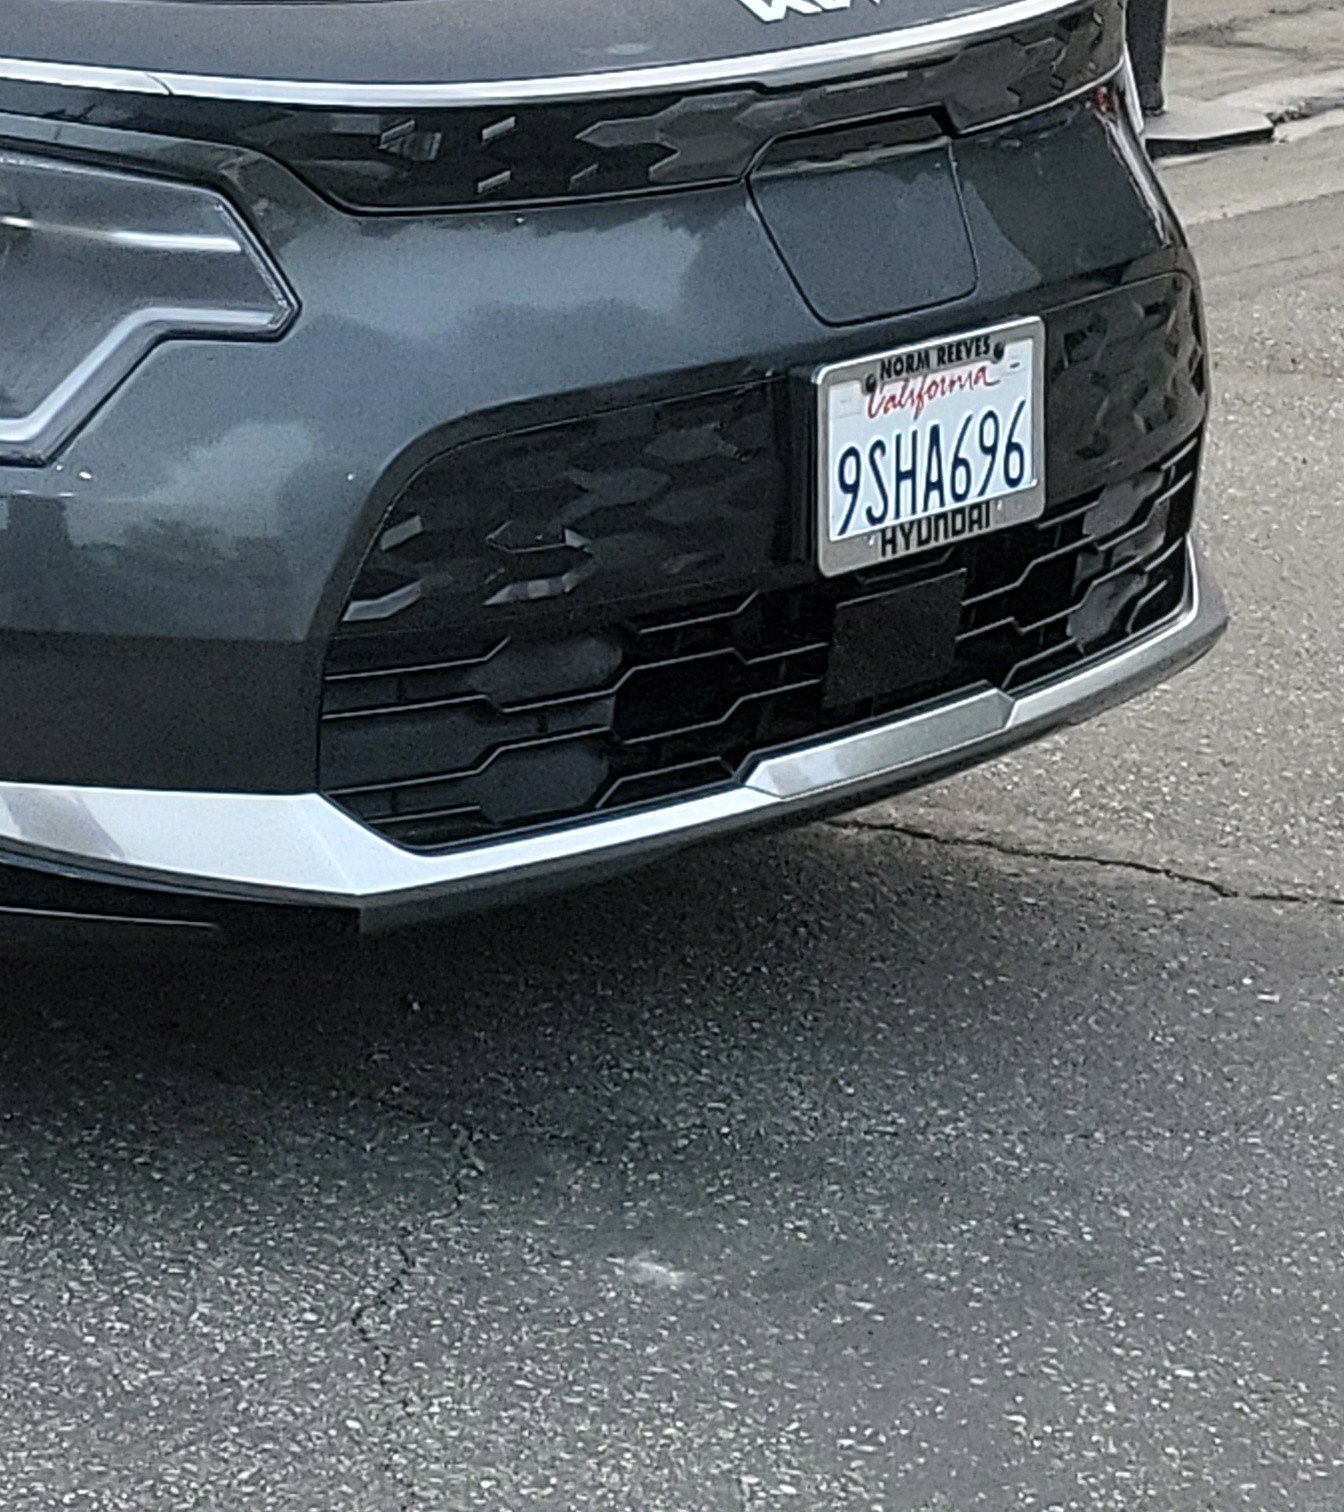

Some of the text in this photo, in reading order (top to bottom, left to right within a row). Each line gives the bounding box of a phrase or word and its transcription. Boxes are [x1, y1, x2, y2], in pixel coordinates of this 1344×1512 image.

[879, 336, 991, 381] NORM REEVES
[865, 363, 1000, 420] California
[837, 399, 1027, 536] 9SHA696
[881, 500, 991, 558] HYUNDAI
